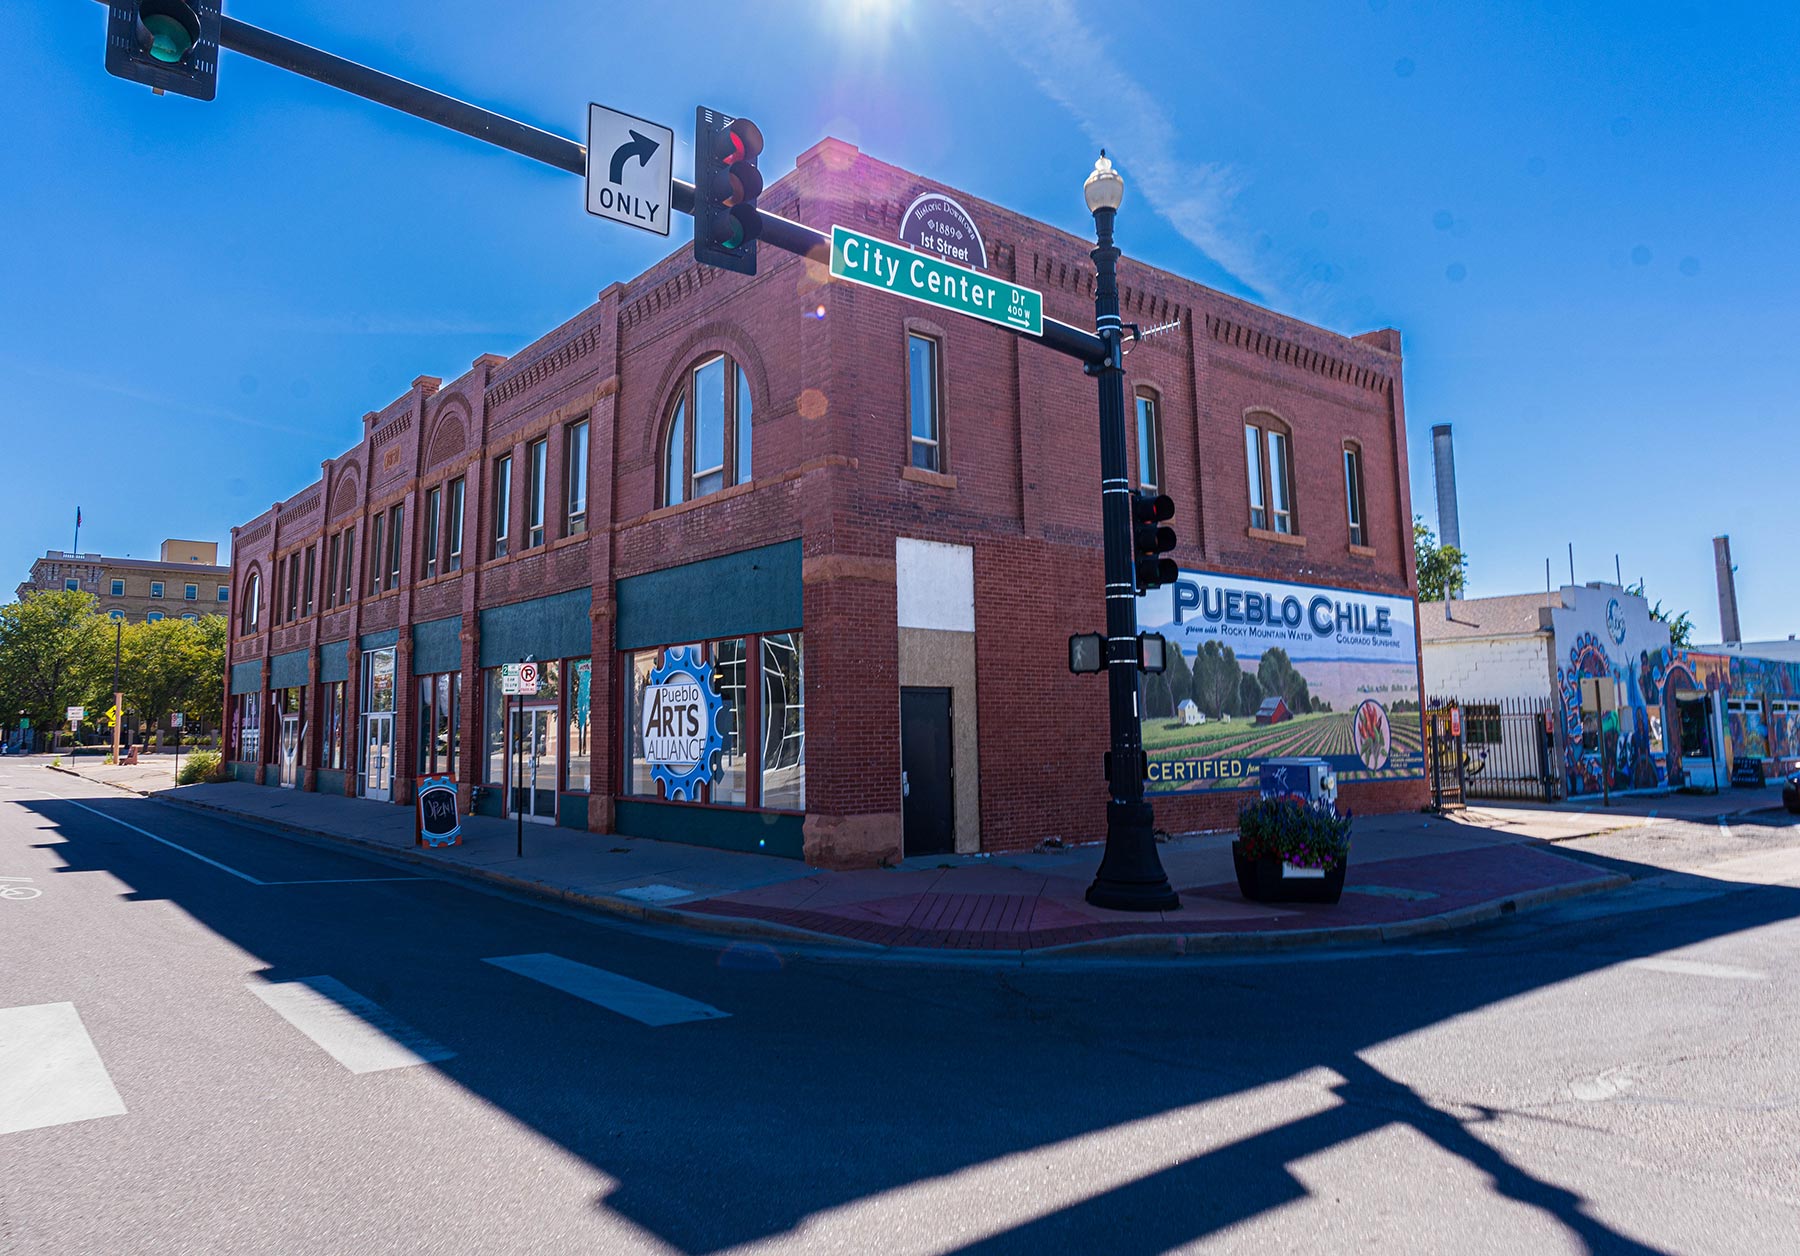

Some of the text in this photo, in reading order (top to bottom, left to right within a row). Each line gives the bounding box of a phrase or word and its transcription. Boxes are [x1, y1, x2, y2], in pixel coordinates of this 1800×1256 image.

[599, 187, 659, 223] ONLY
[914, 201, 976, 241] Historic Downtown
[935, 221, 956, 238] 1889
[921, 232, 969, 262] 1st Street
[843, 238, 996, 309] City Center
[1012, 289, 1026, 306] Dr
[1007, 304, 1031, 320] 400 W
[1172, 579, 1393, 638] PUEBLO CHILE
[1221, 624, 1247, 637] ROCKY
[1249, 626, 1286, 640] MOUNTAIN
[1287, 629, 1313, 642] WATER
[1336, 633, 1401, 649] COLORADO SUNSHINE
[662, 685, 699, 703] Pueblo
[645, 688, 699, 738] ARTS
[647, 738, 706, 761] ALLIANCE
[1147, 759, 1242, 781] CERTIFIED
